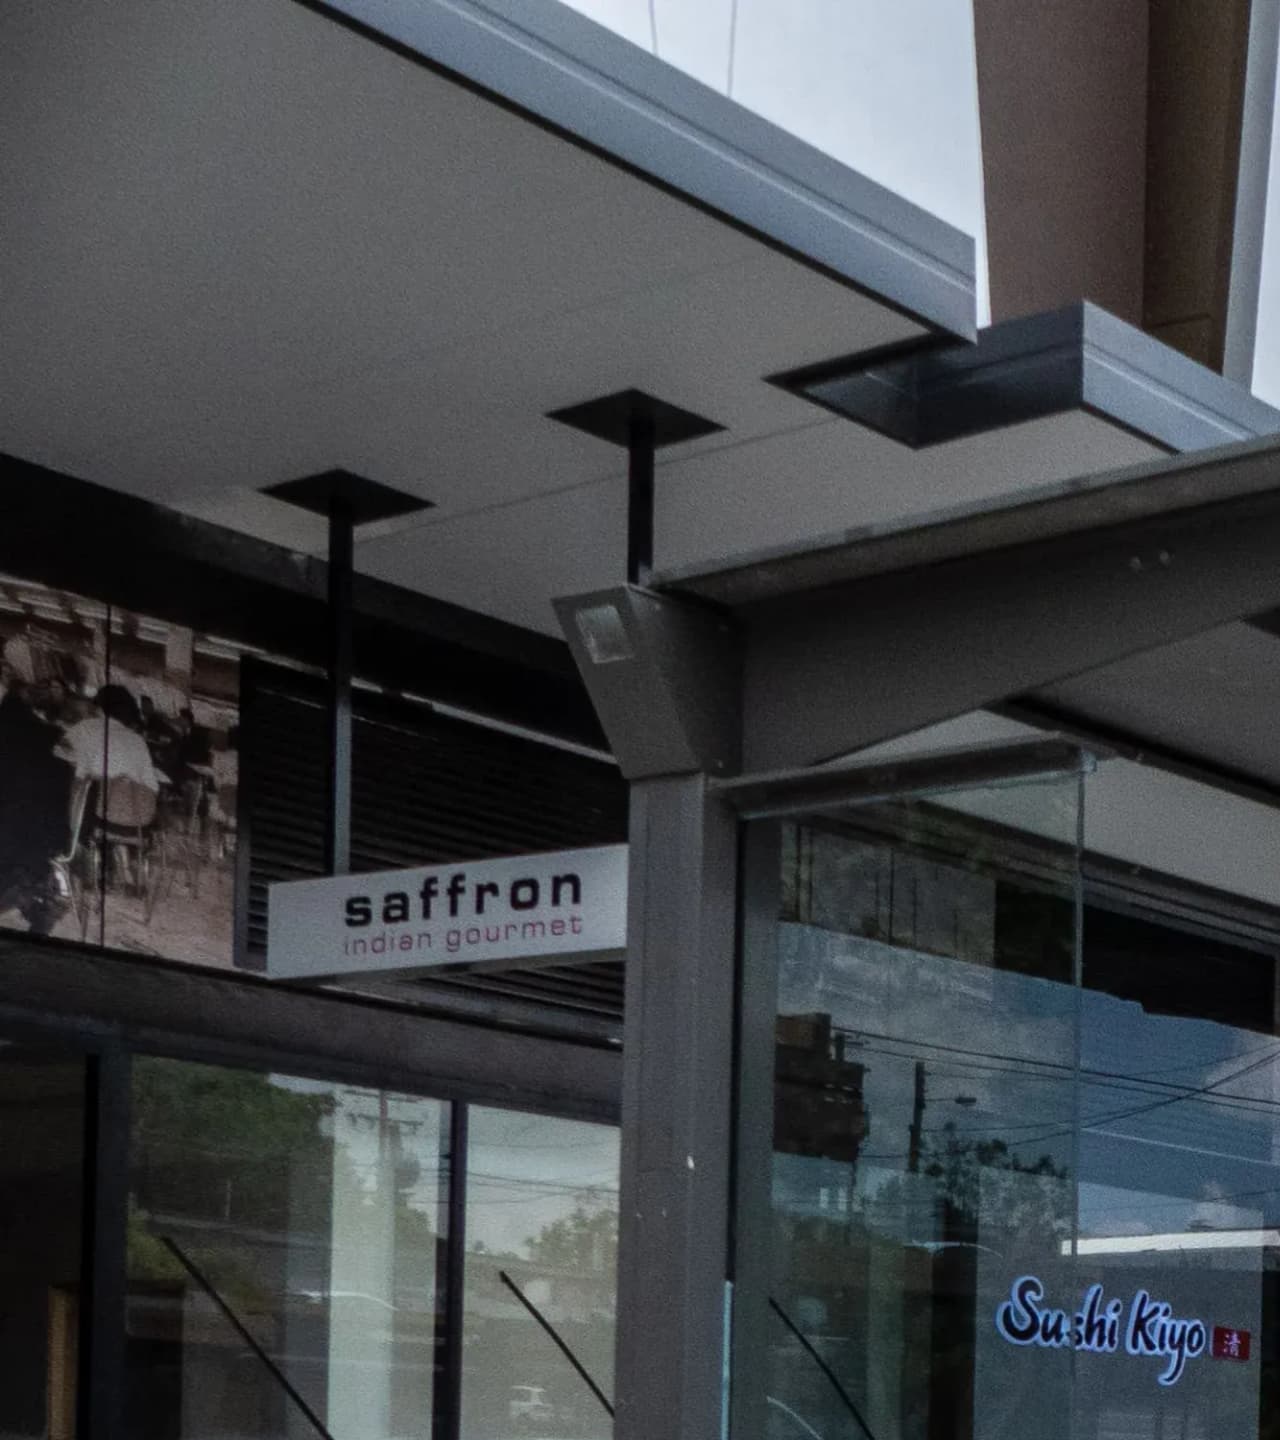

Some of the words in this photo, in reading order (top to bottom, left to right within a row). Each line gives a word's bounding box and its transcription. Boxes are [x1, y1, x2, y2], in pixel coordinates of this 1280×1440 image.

[344, 871, 582, 928] saffron
[344, 931, 433, 957] indian
[446, 915, 583, 953] gourmet
[996, 1275, 1121, 1351] Sushi
[1124, 1288, 1207, 1386] Kiyo
